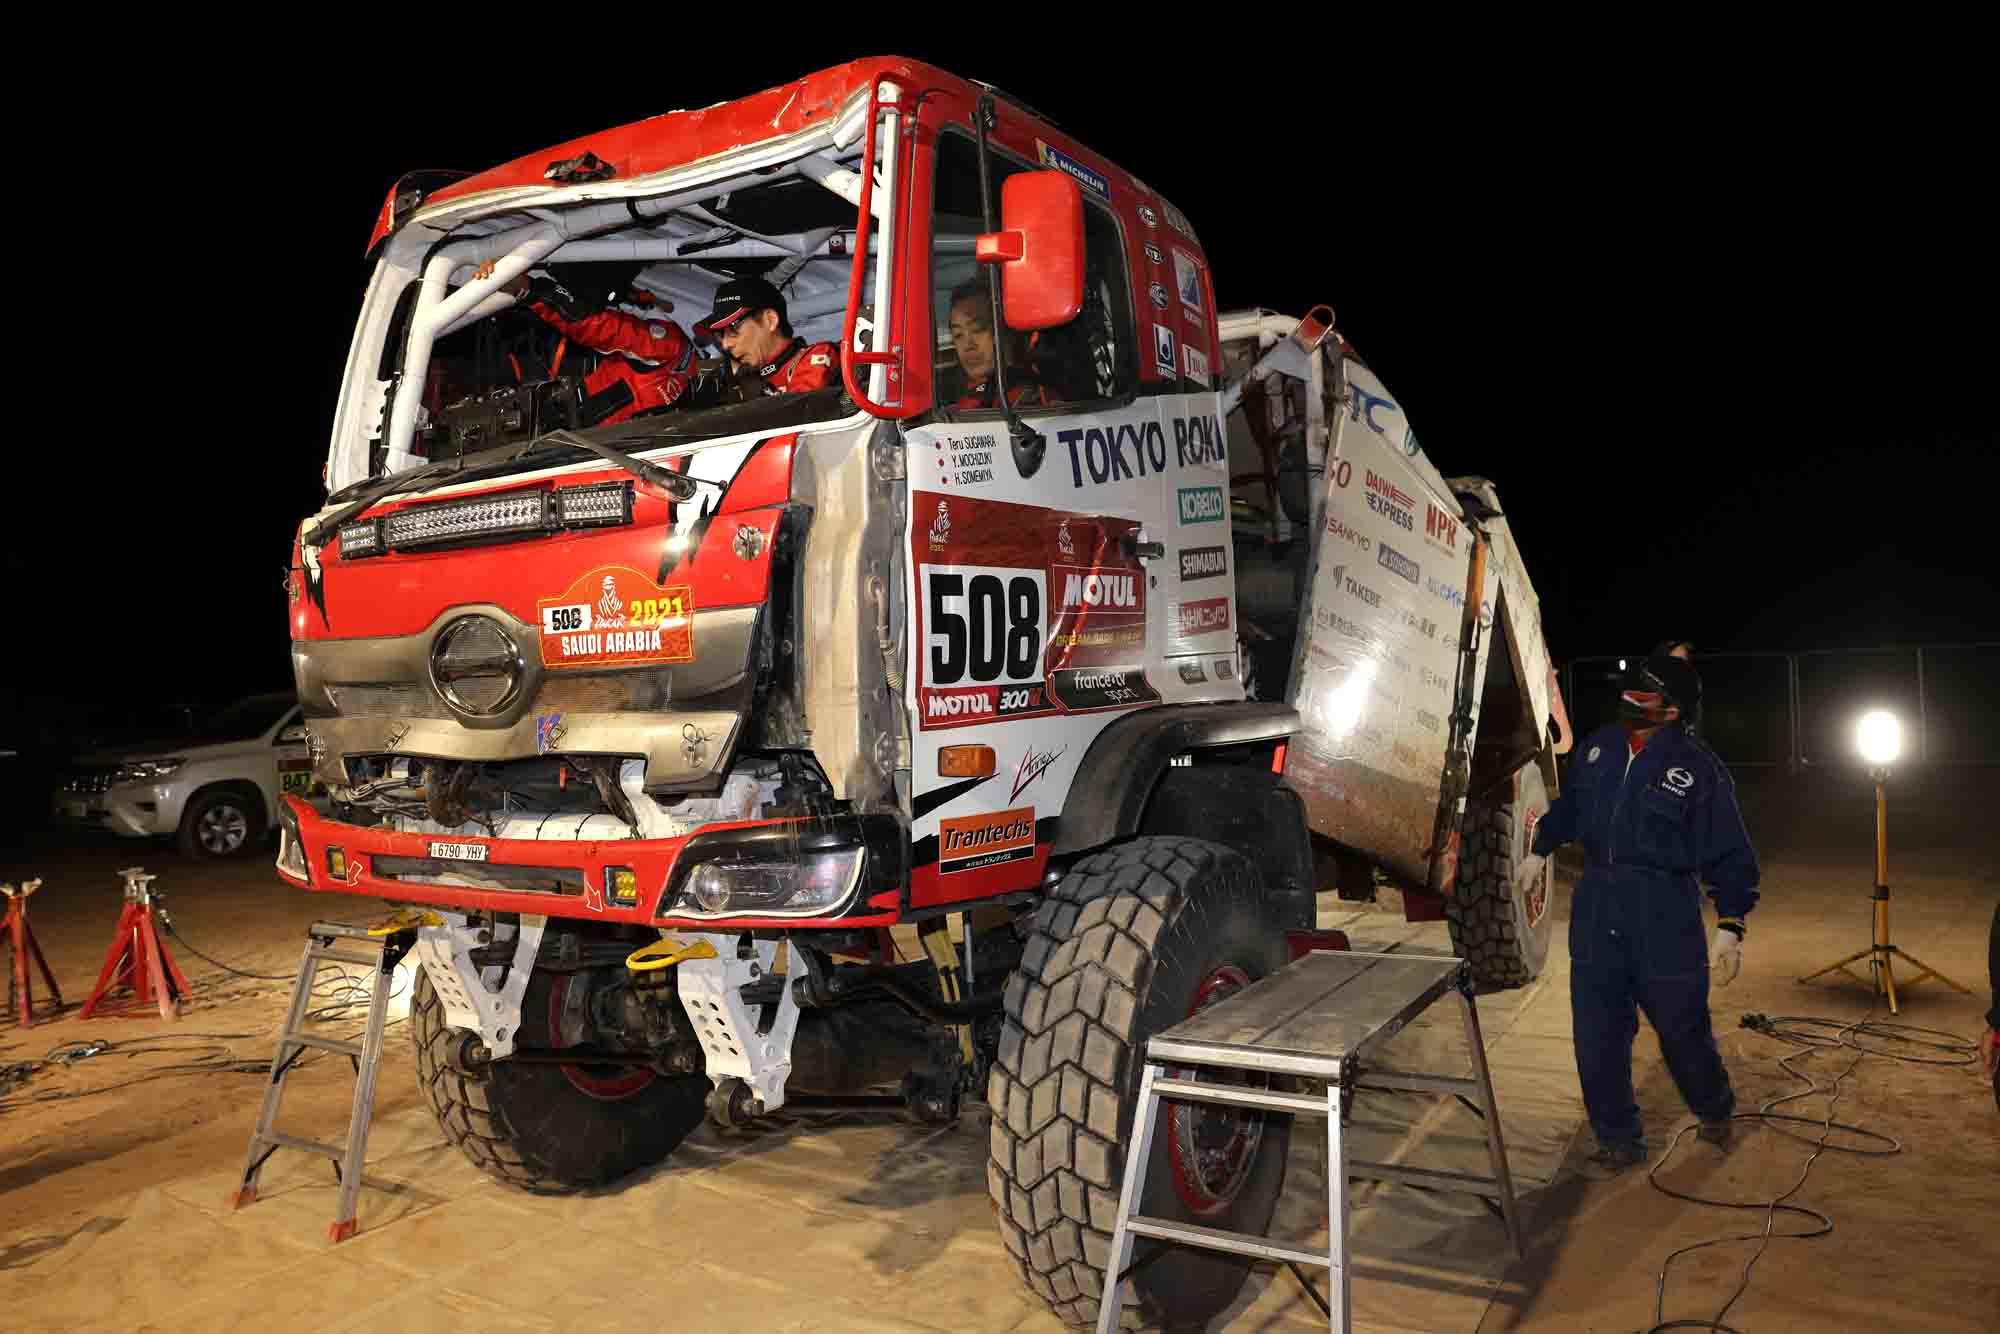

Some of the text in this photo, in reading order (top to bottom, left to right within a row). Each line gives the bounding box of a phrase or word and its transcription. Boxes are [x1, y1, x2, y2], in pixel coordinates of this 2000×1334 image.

[1060, 159, 1104, 192] MICHELIN
[947, 437, 963, 451] Teru
[1057, 421, 1166, 488] TOKYO
[1367, 495, 1413, 531] EXPRESS
[1426, 503, 1457, 548] NPK
[1181, 551, 1226, 577] SHIMABUN
[1064, 574, 1137, 606] MOTUL
[629, 597, 684, 626] 2021
[561, 629, 662, 656] SAUDI ARABIA
[929, 573, 1040, 684] 508
[928, 693, 993, 717] MOTUL
[1105, 687, 1139, 704] sport
[1661, 781, 1686, 797] HINO
[945, 817, 1031, 852] Trantechs
[439, 843, 461, 858] 6790
